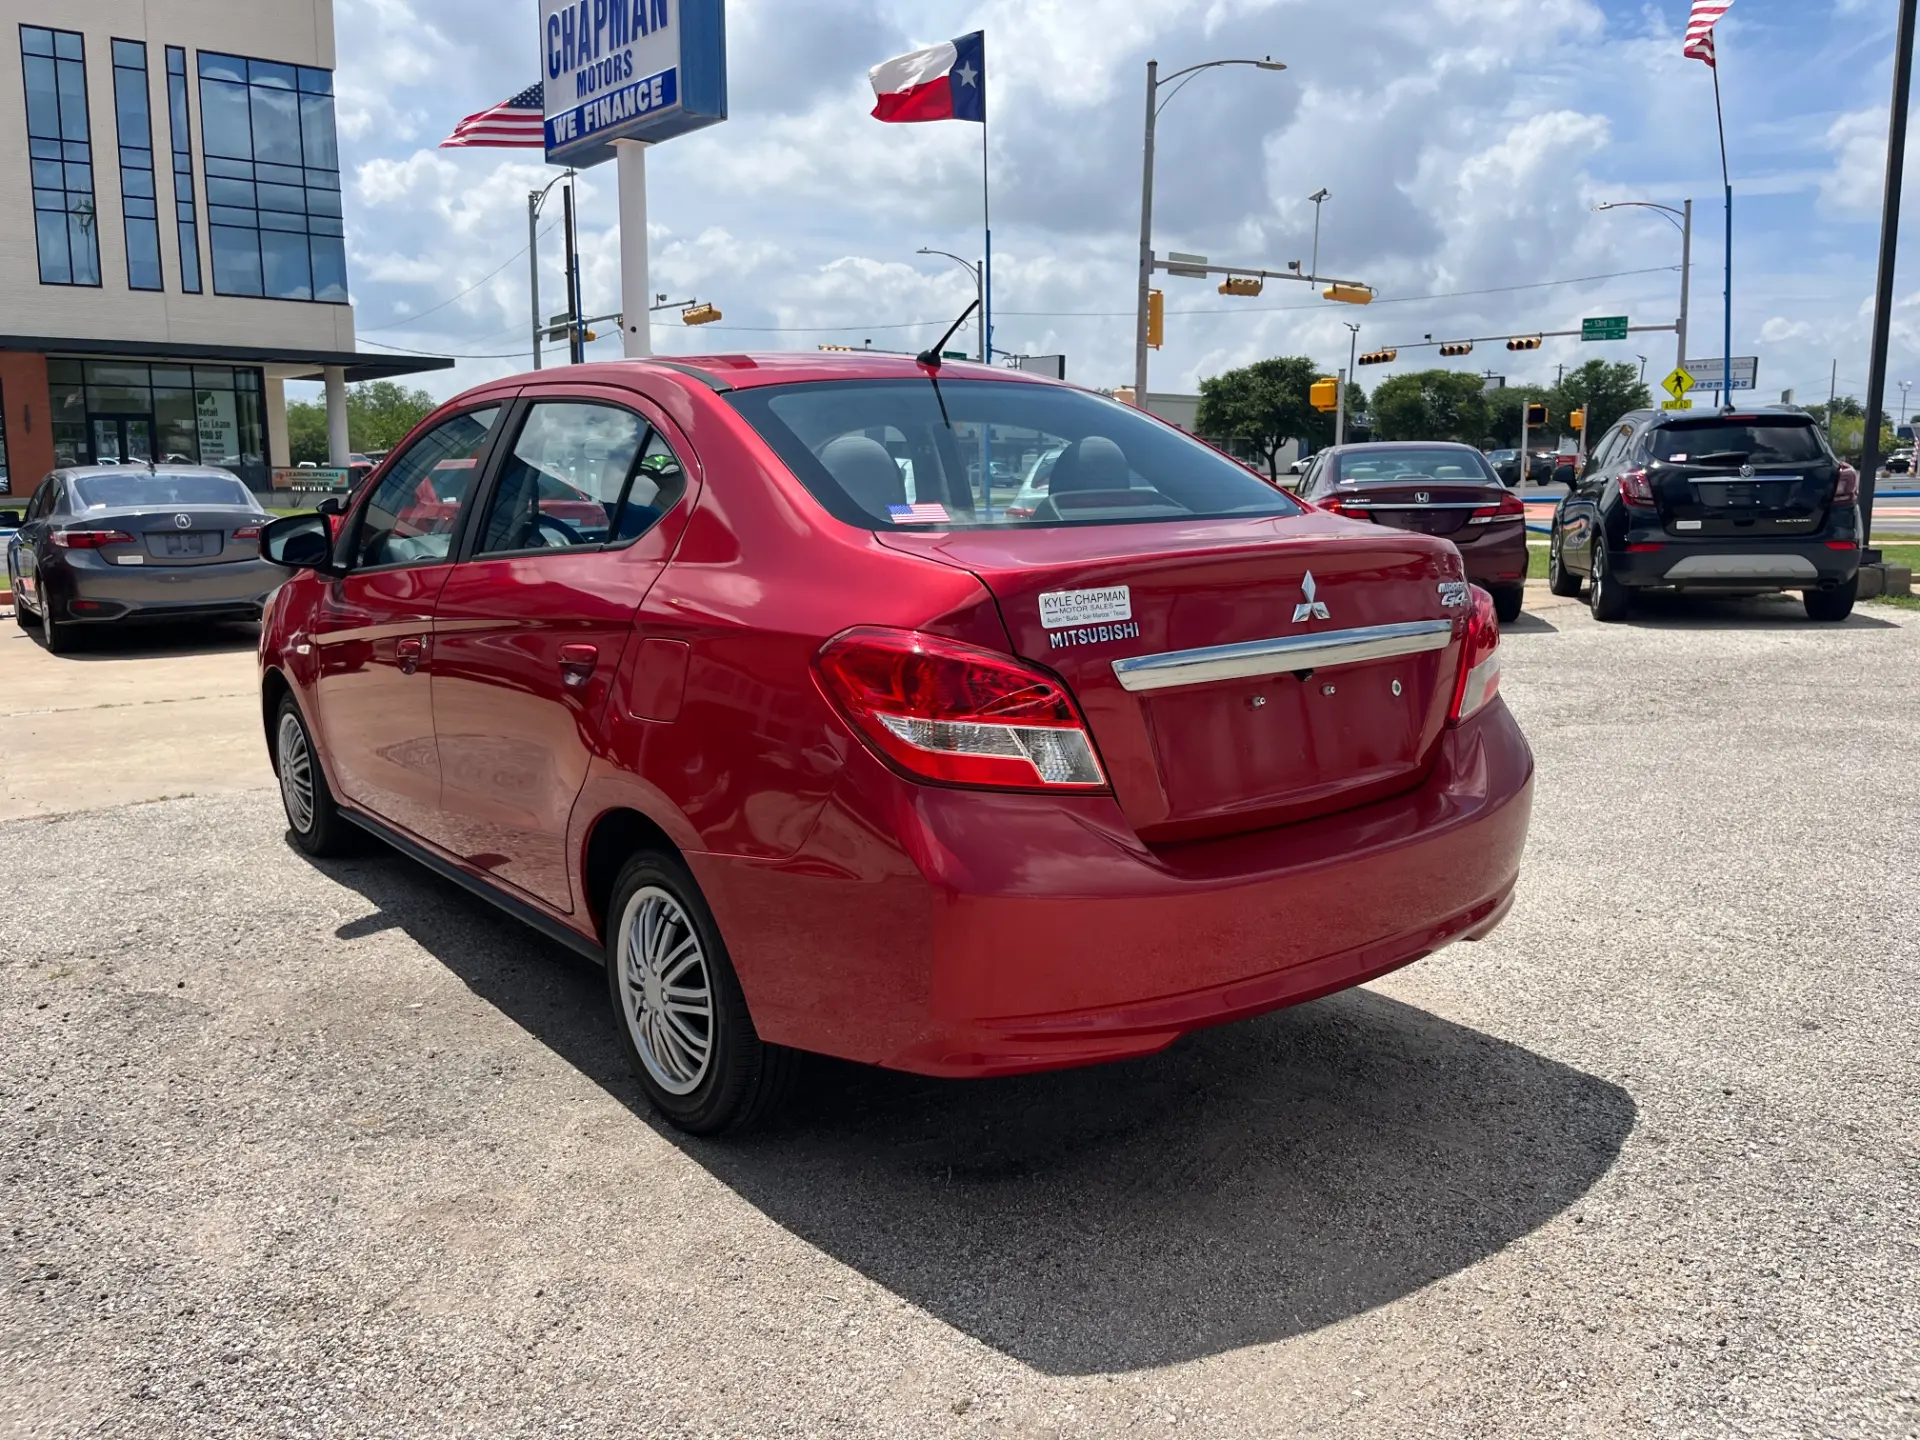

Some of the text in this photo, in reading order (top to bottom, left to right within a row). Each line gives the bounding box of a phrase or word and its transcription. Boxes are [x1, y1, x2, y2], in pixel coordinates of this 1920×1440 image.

[576, 49, 633, 99] MOTORS
[553, 75, 664, 144] WE FINANCE
[198, 407, 218, 417] Retail
[1664, 401, 1689, 409] AHEAD
[211, 419, 231, 429] Lease
[1044, 590, 1126, 608] KYLE CHAPMAN
[1441, 592, 1466, 607] G4
[1059, 605, 1088, 614] MOTOR
[1049, 622, 1140, 649] MITSUBISHI
